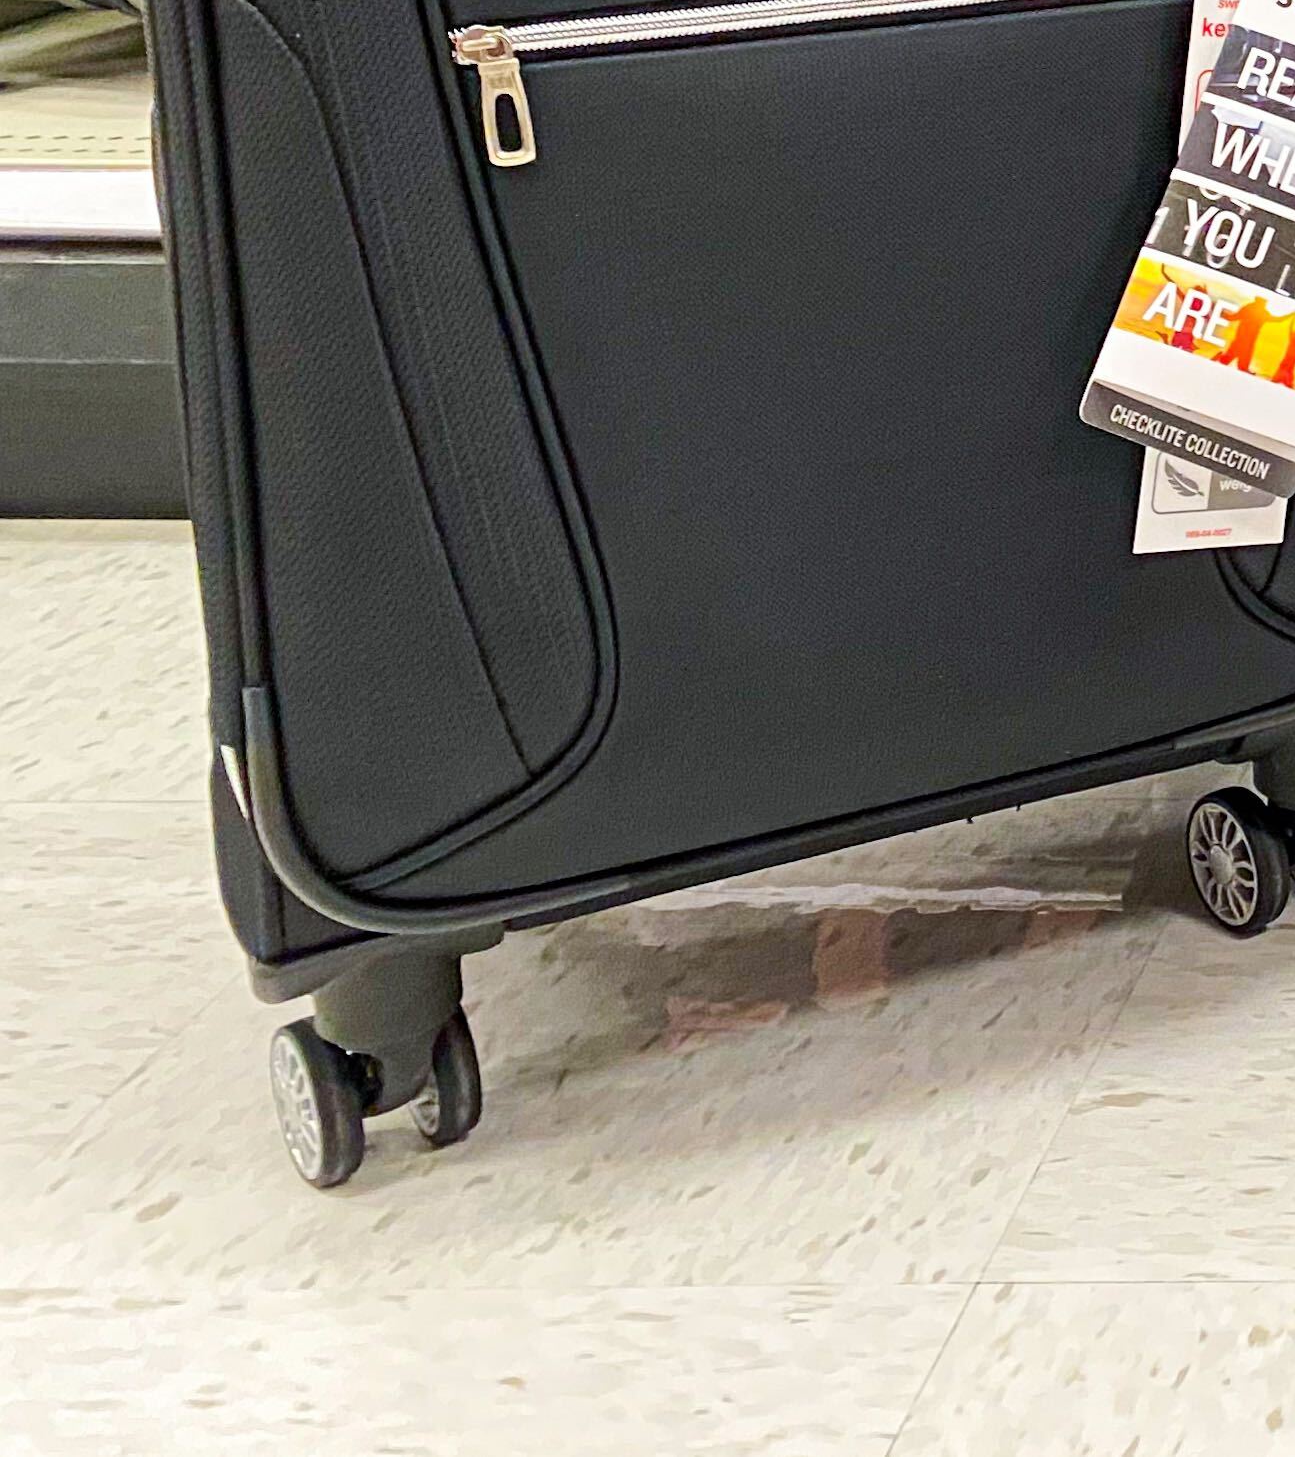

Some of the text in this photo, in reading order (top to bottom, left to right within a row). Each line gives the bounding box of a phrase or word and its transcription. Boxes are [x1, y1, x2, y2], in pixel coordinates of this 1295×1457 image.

[1183, 198, 1276, 269] YOU
[1142, 282, 1239, 349] ARE
[1109, 404, 1271, 480] CHECKLITE COLLECTION
